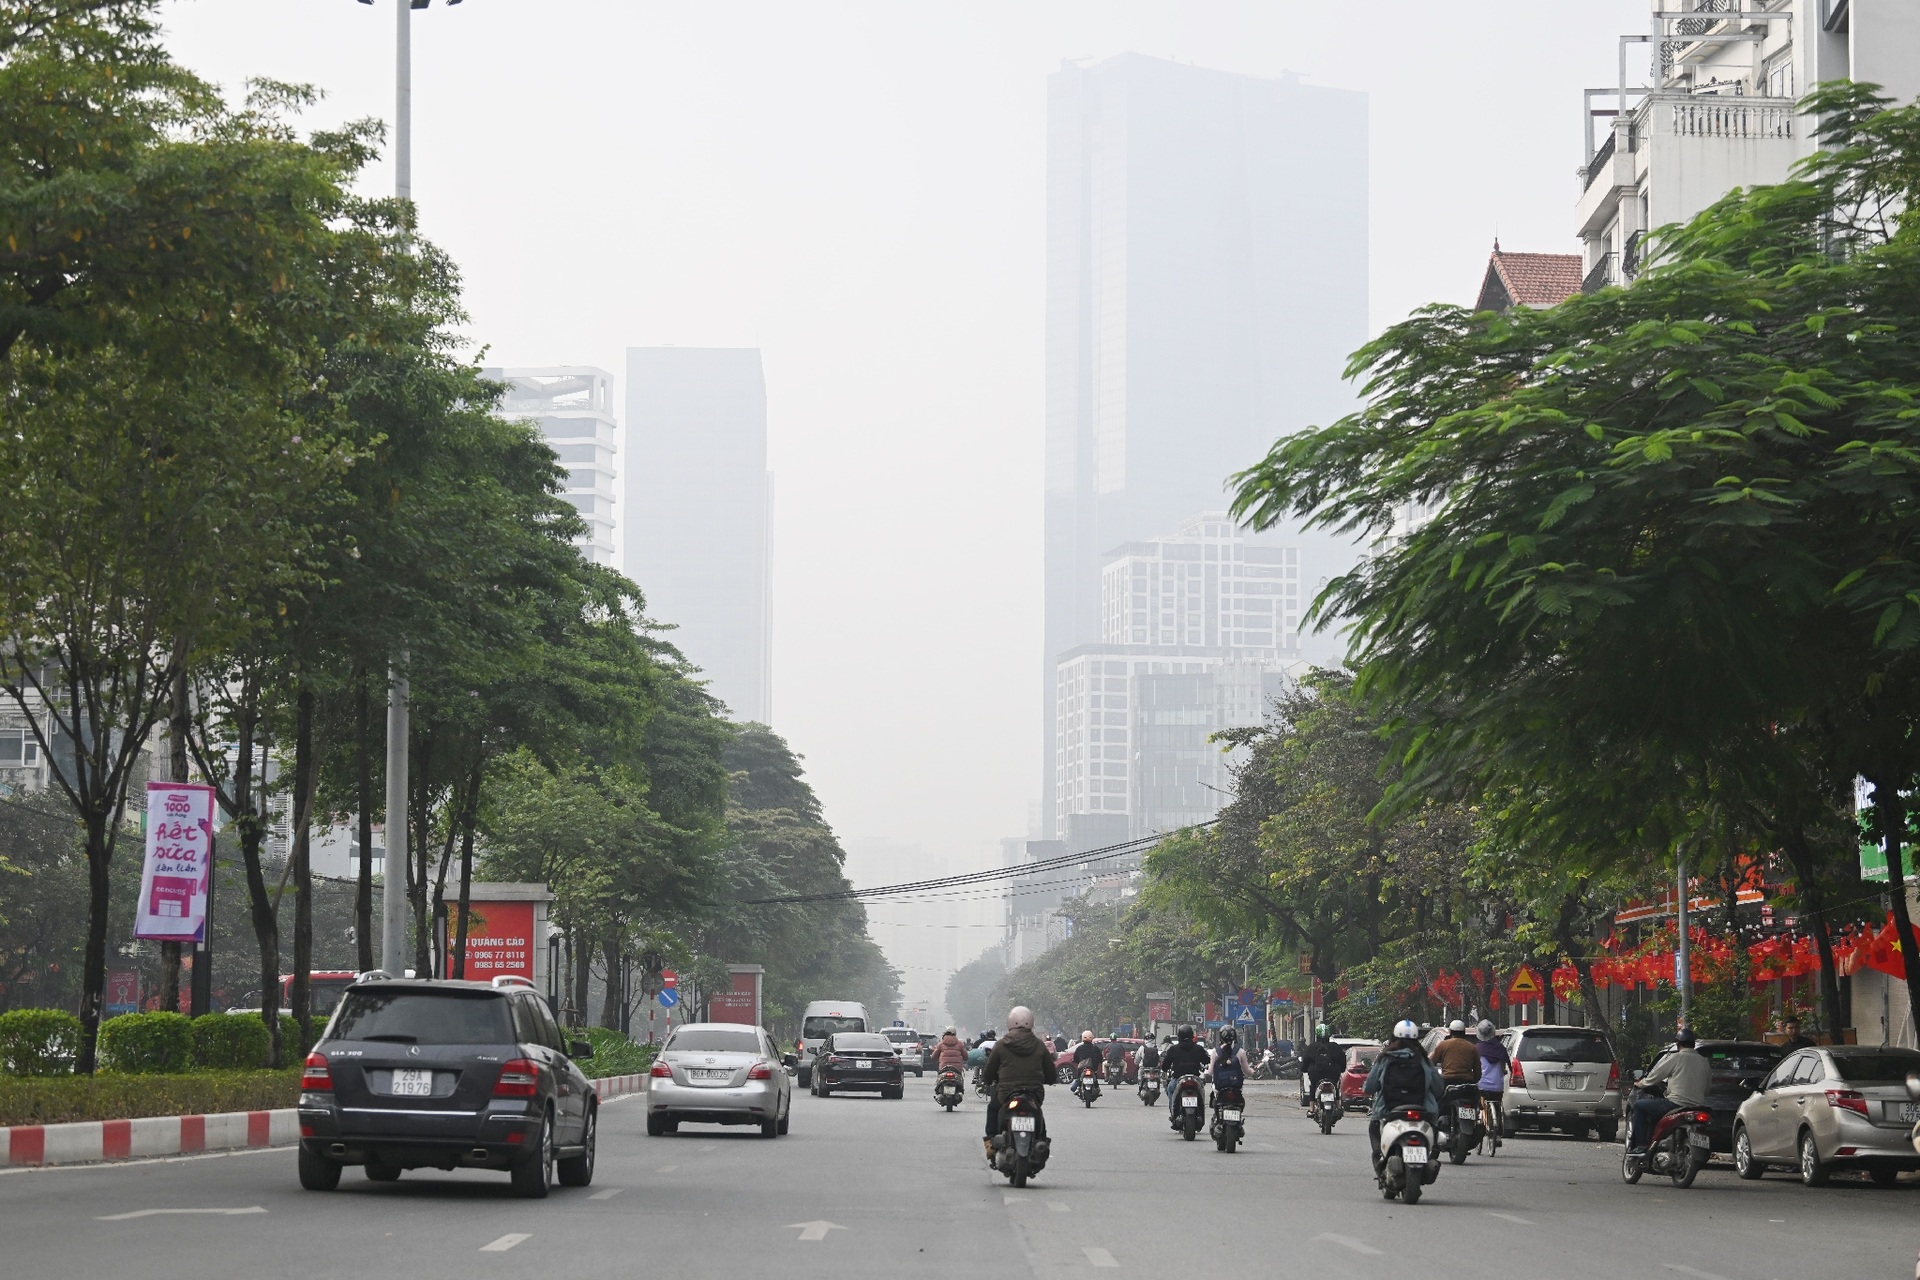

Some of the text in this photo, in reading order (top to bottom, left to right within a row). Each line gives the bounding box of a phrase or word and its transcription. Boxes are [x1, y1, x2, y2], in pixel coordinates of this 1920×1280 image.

[164, 803, 190, 813] 1000
[155, 821, 197, 841] hết
[152, 843, 197, 862] sữa
[474, 951, 493, 959] 0965
[494, 951, 505, 959] 77
[402, 1070, 422, 1081] 29A
[1905, 1103, 1920, 1112] 30E
